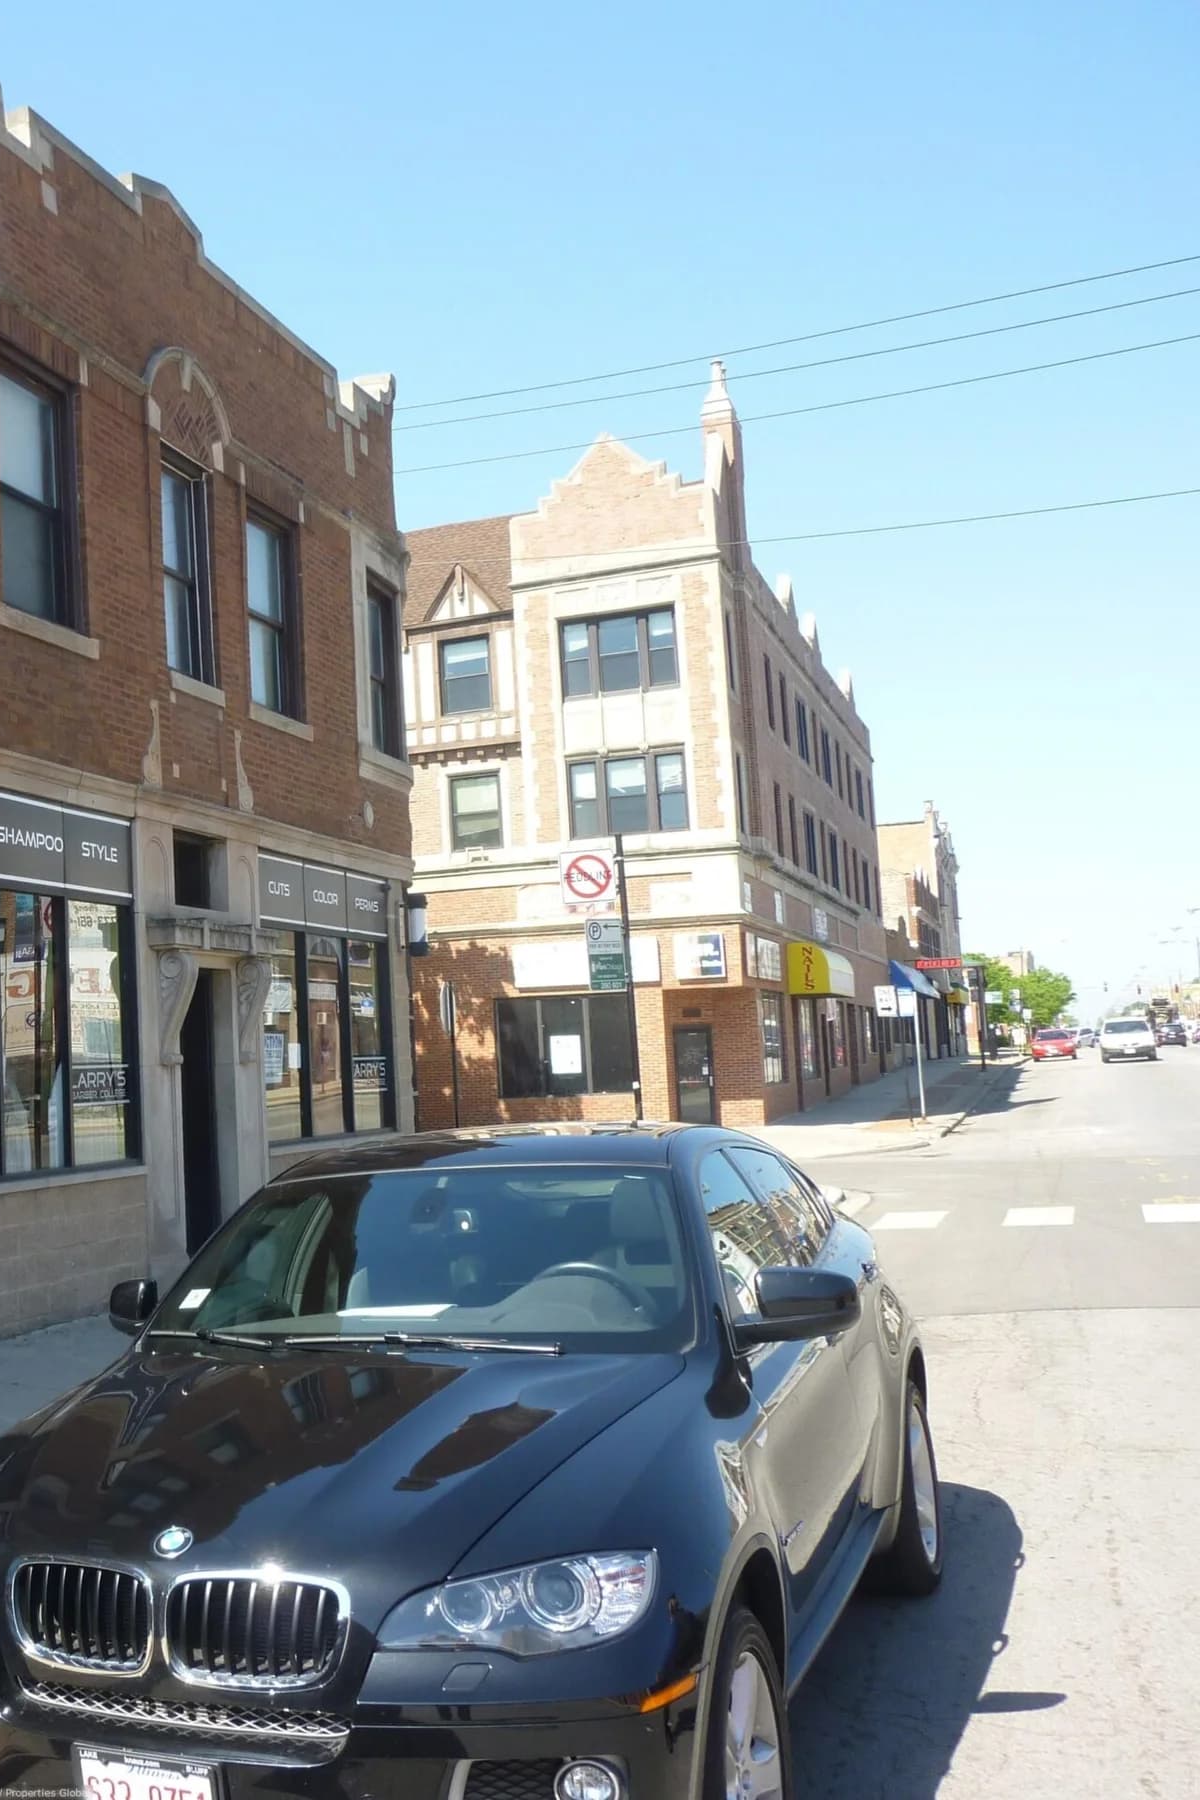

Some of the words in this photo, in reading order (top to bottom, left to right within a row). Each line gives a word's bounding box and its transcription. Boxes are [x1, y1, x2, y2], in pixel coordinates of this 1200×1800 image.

[81, 841, 118, 863] STYLE
[268, 880, 291, 897] CUTS
[312, 889, 339, 906] COLOR
[354, 897, 379, 913] PERMS
[801, 946, 816, 991] NAILS
[353, 1061, 386, 1078] ARRY'S
